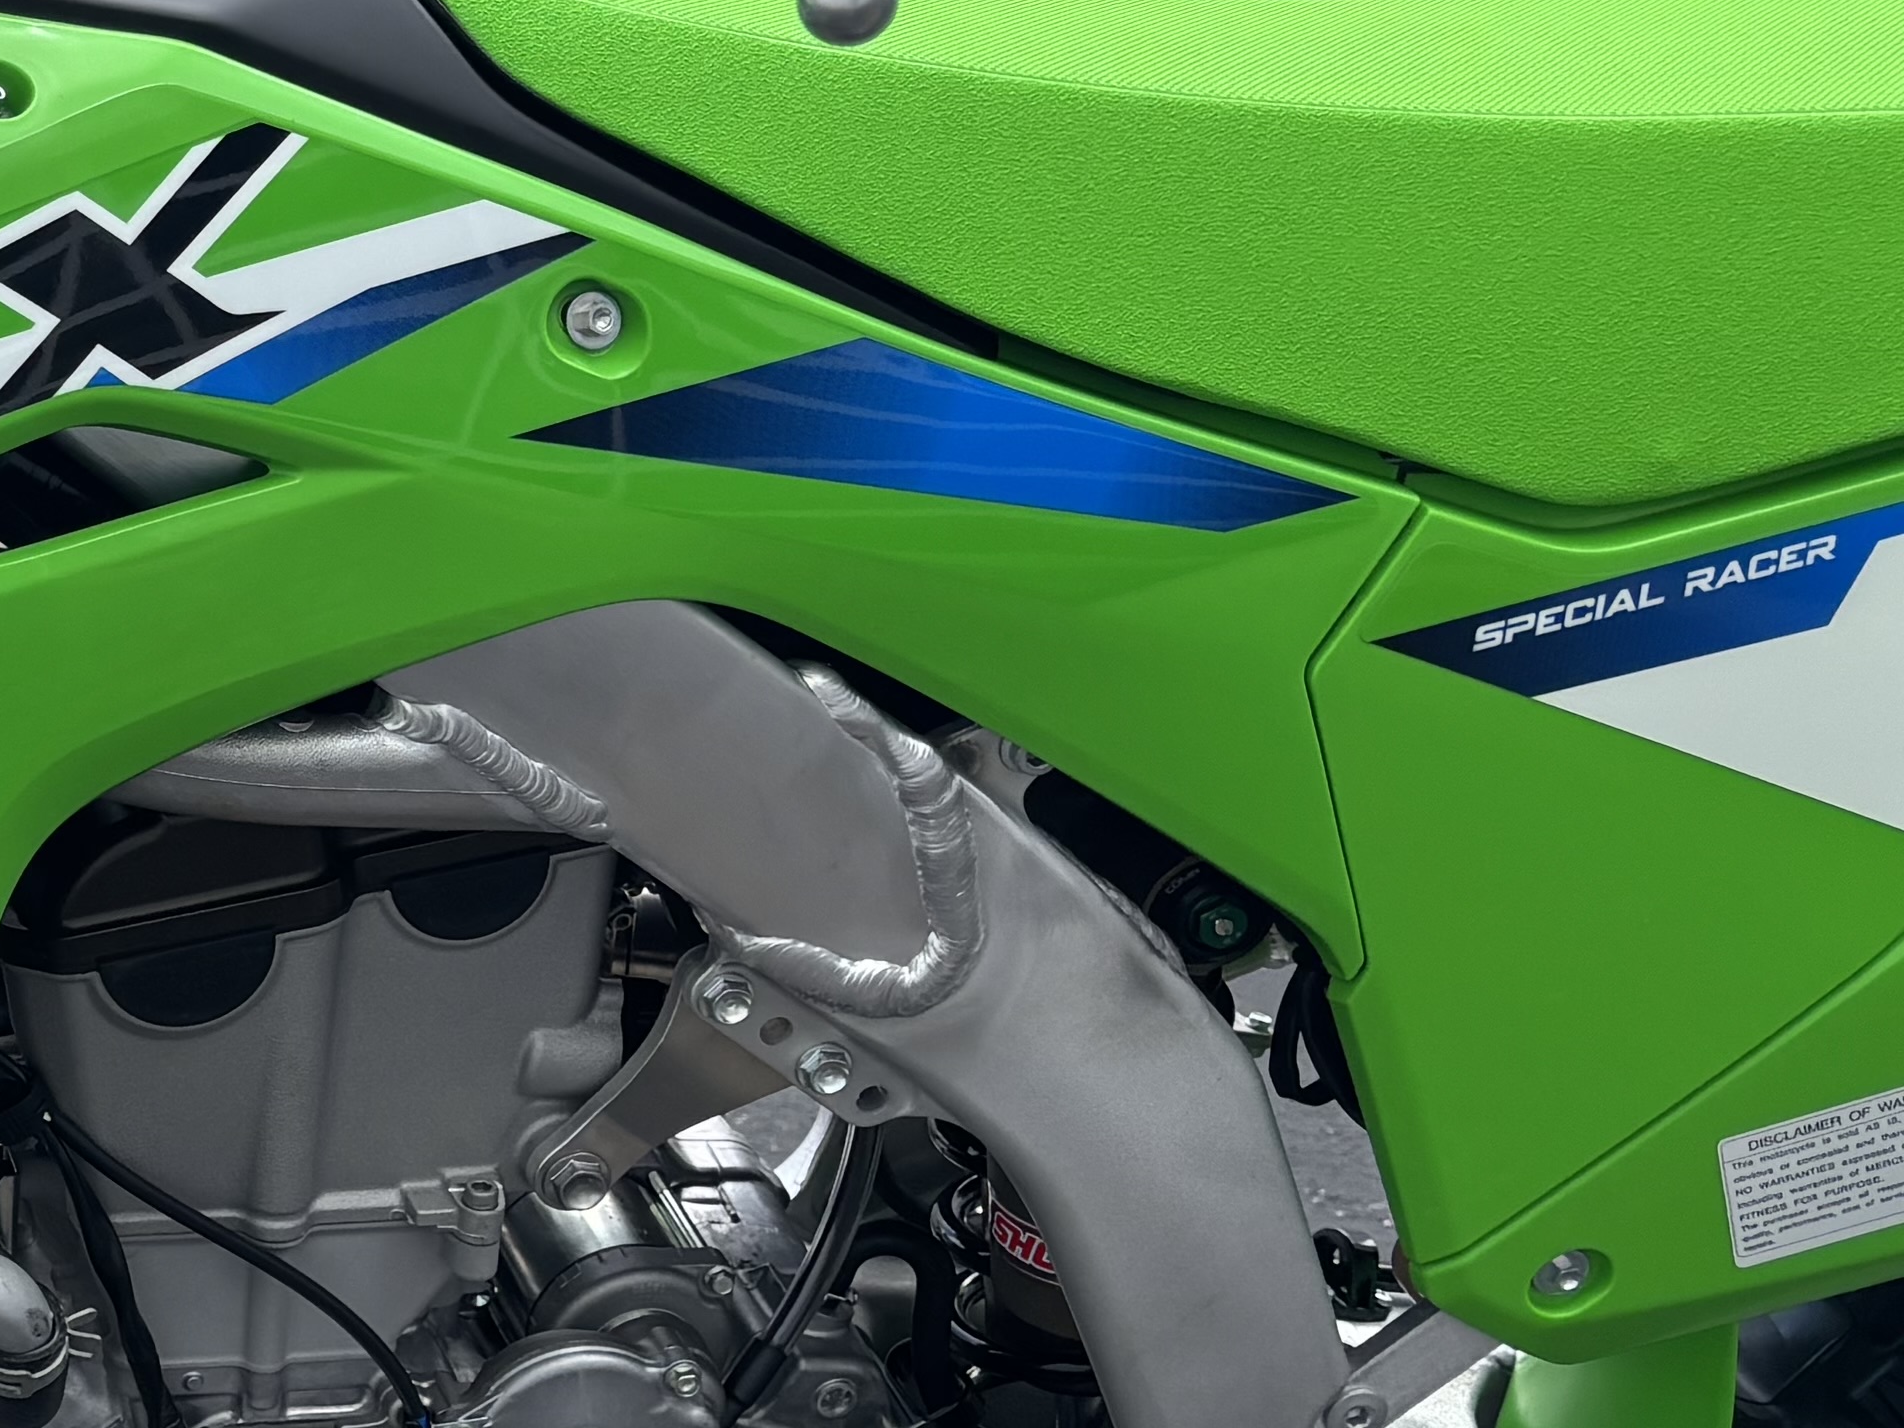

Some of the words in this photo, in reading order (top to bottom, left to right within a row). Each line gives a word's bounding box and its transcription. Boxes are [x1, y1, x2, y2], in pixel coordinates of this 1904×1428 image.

[1473, 582, 1663, 653] SPECIAL
[1683, 534, 1837, 597] RACER
[1748, 1116, 1841, 1151] DISCLAIMER
[1849, 1107, 1872, 1121] OF
[1736, 1186, 1752, 1196] NO
[1759, 1162, 1835, 1190] WARRANTIES
[1739, 1203, 1787, 1221] FITNESS
[1794, 1194, 1817, 1207] FOR
